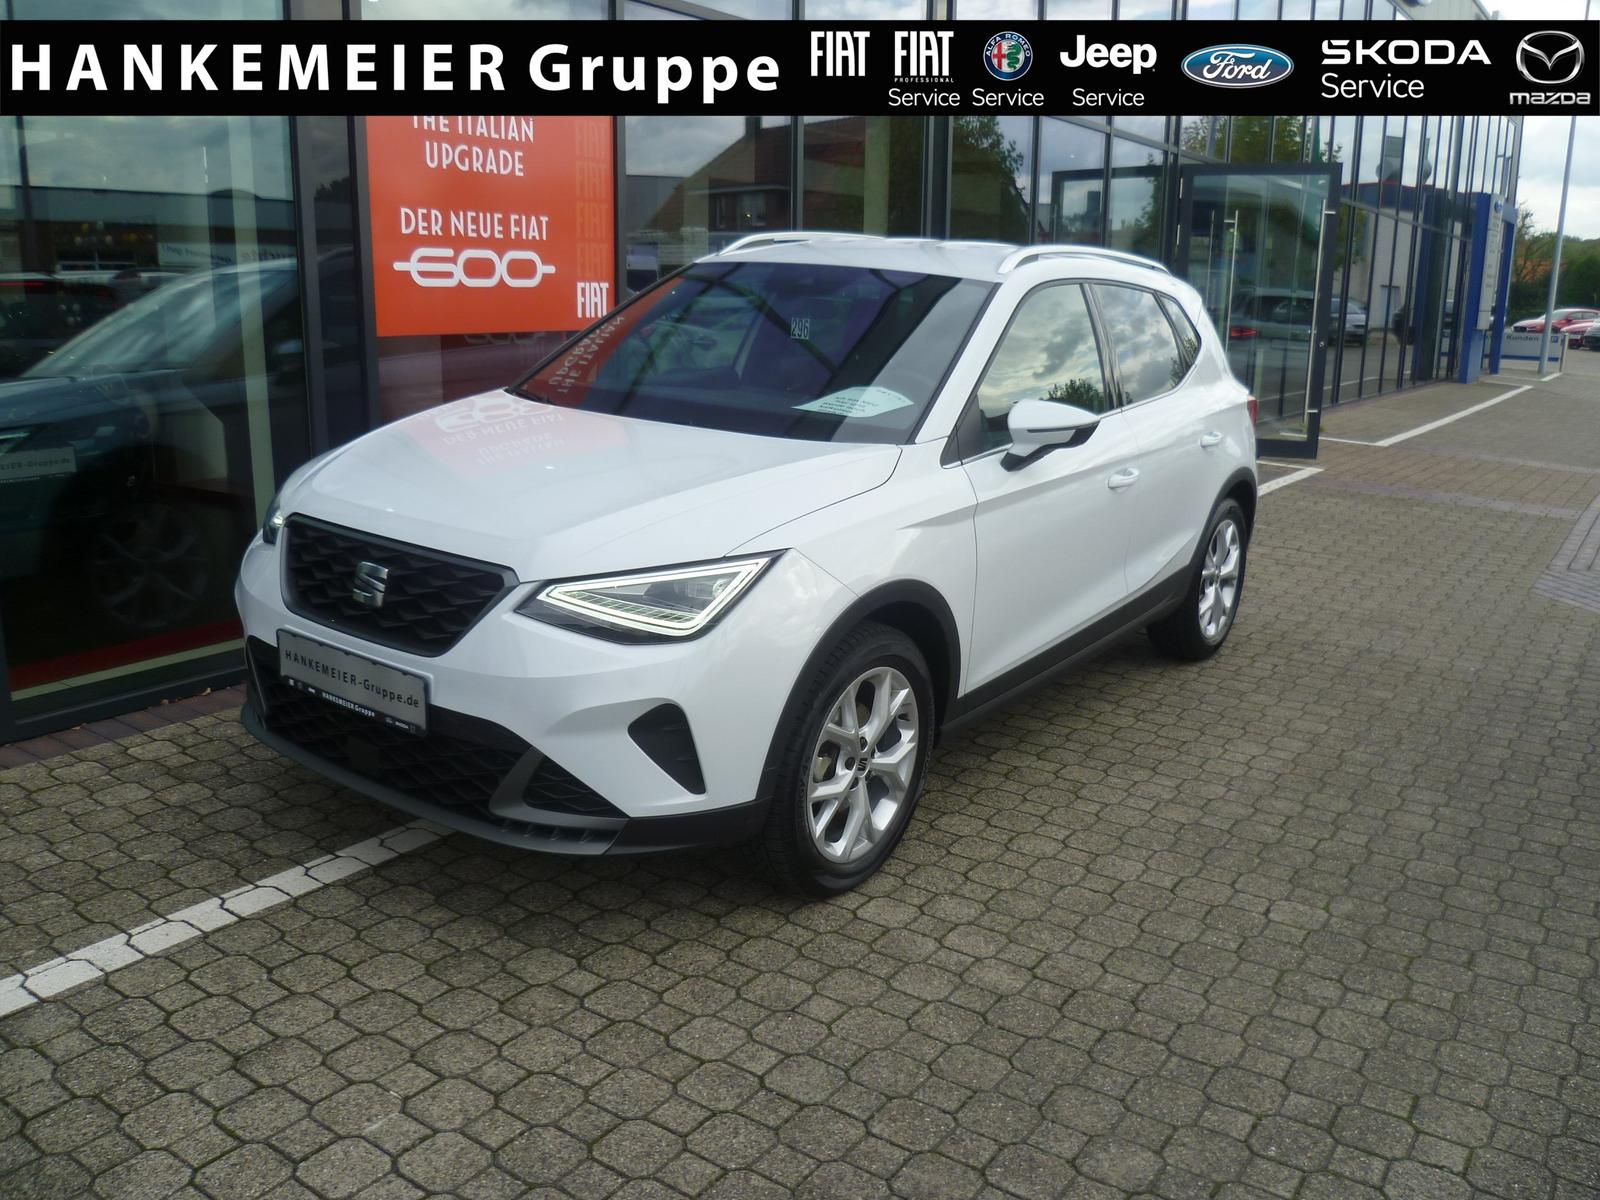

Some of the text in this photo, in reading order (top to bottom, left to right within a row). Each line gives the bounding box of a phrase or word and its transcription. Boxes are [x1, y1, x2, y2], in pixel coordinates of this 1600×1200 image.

[425, 141, 525, 177] UPGRADE
[400, 207, 549, 241] DER NEUE FIAT
[409, 247, 544, 288] 600
[576, 282, 609, 318] FIAT
[285, 650, 420, 708] HANKEMEIER-Gruppe.de
